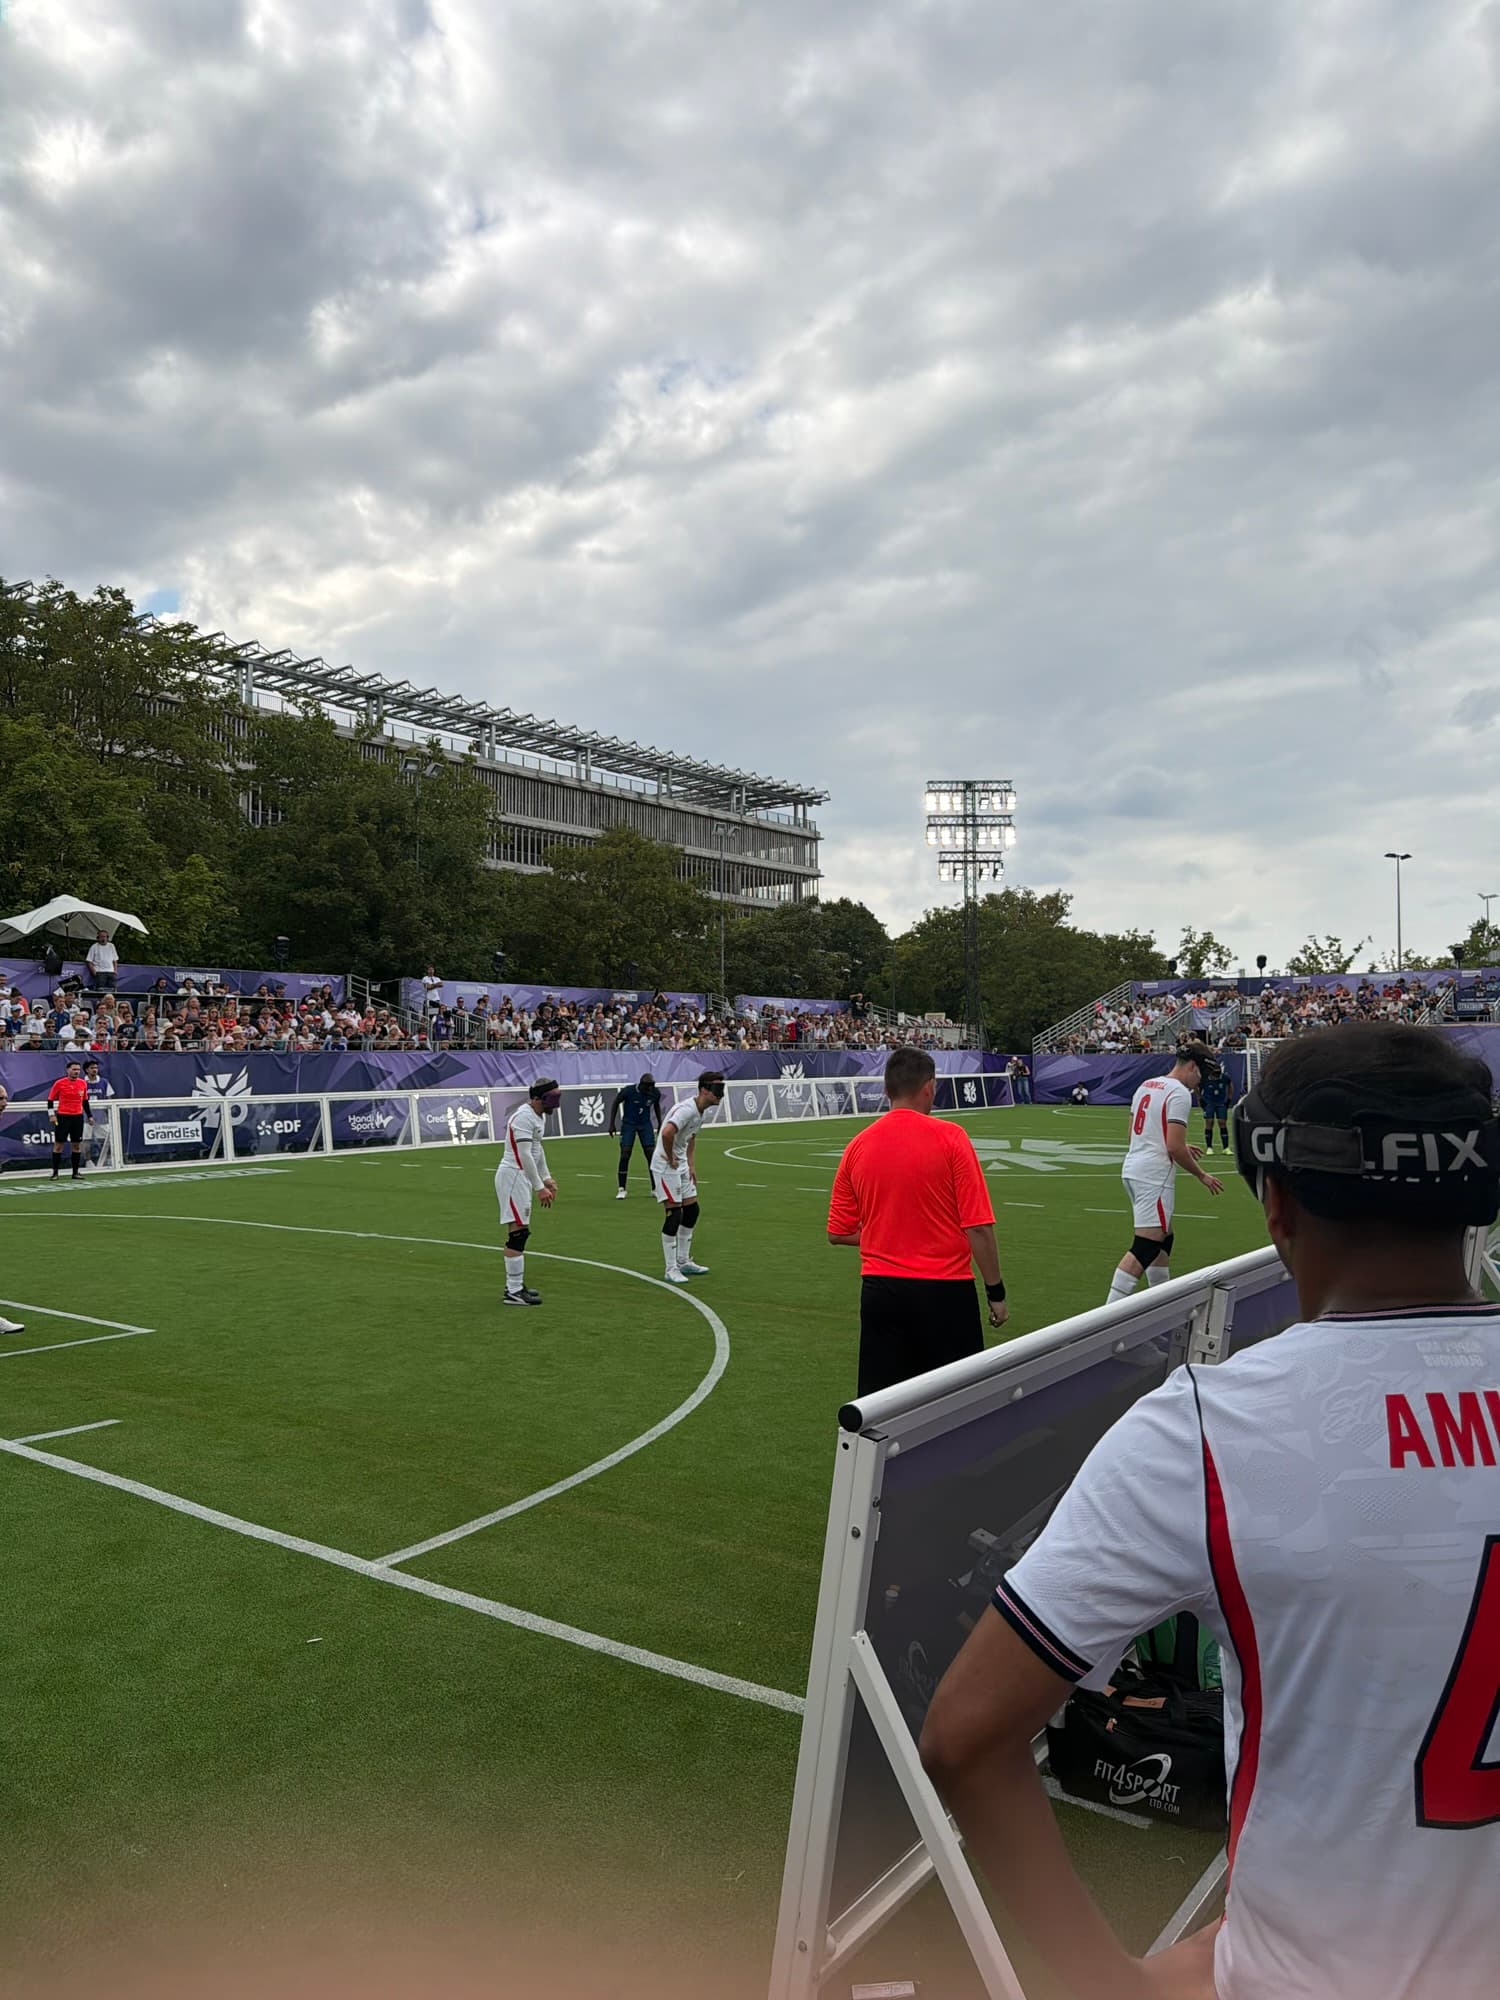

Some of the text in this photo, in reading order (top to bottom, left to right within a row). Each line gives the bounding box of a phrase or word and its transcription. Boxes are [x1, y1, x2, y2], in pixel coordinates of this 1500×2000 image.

[350, 1120, 373, 1129] Sport
[1133, 1093, 1151, 1135] 6
[1251, 1126, 1488, 1172] GFIX
